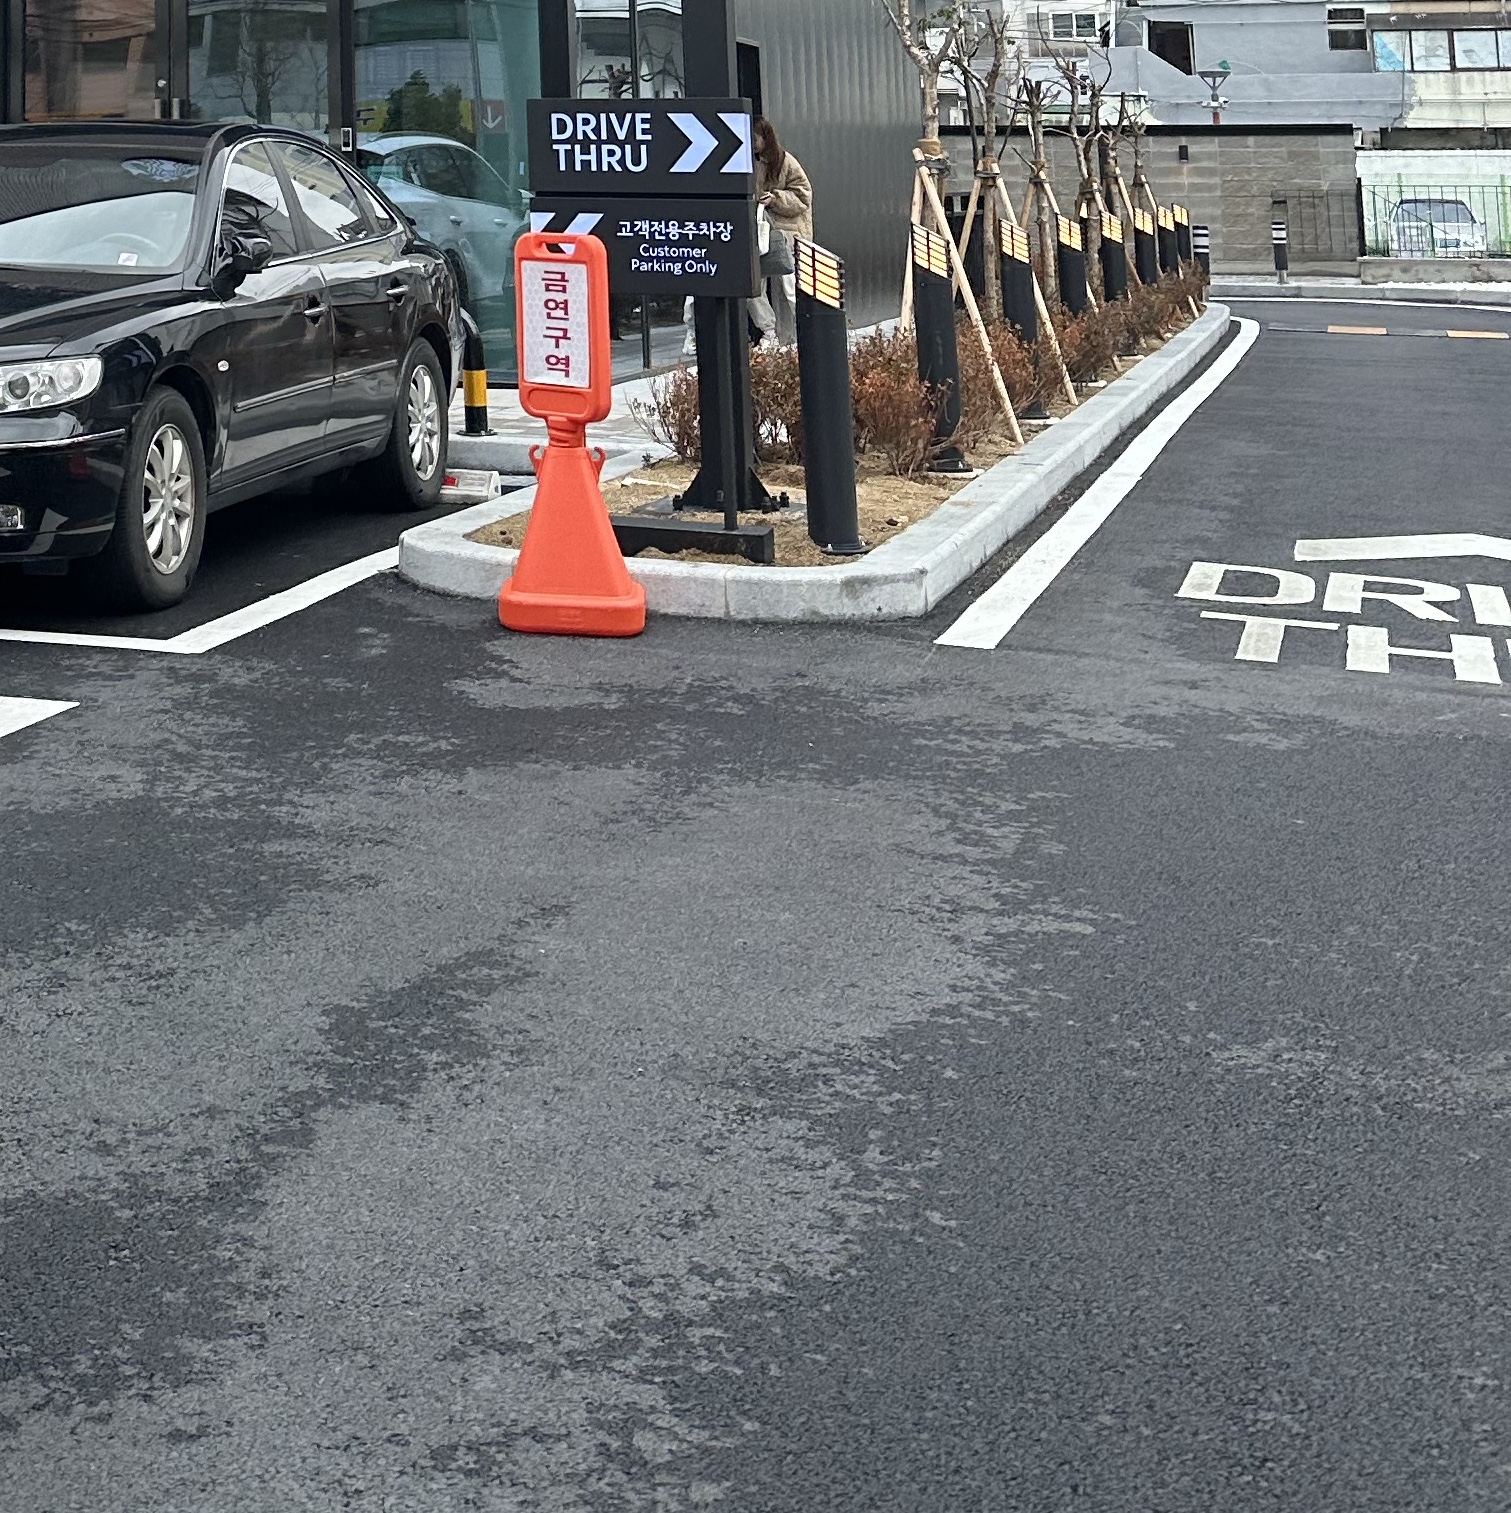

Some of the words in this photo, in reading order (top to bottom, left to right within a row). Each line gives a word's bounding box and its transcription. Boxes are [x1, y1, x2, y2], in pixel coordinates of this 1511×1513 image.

[550, 112, 652, 141] DRIVE
[552, 144, 648, 173] THRU
[617, 220, 734, 242] 고객전용주차장
[639, 243, 708, 259] Customer
[631, 259, 683, 276] Parking
[684, 259, 718, 276] Only
[541, 270, 571, 379] 금연구역
[1199, 610, 1511, 686] TH
